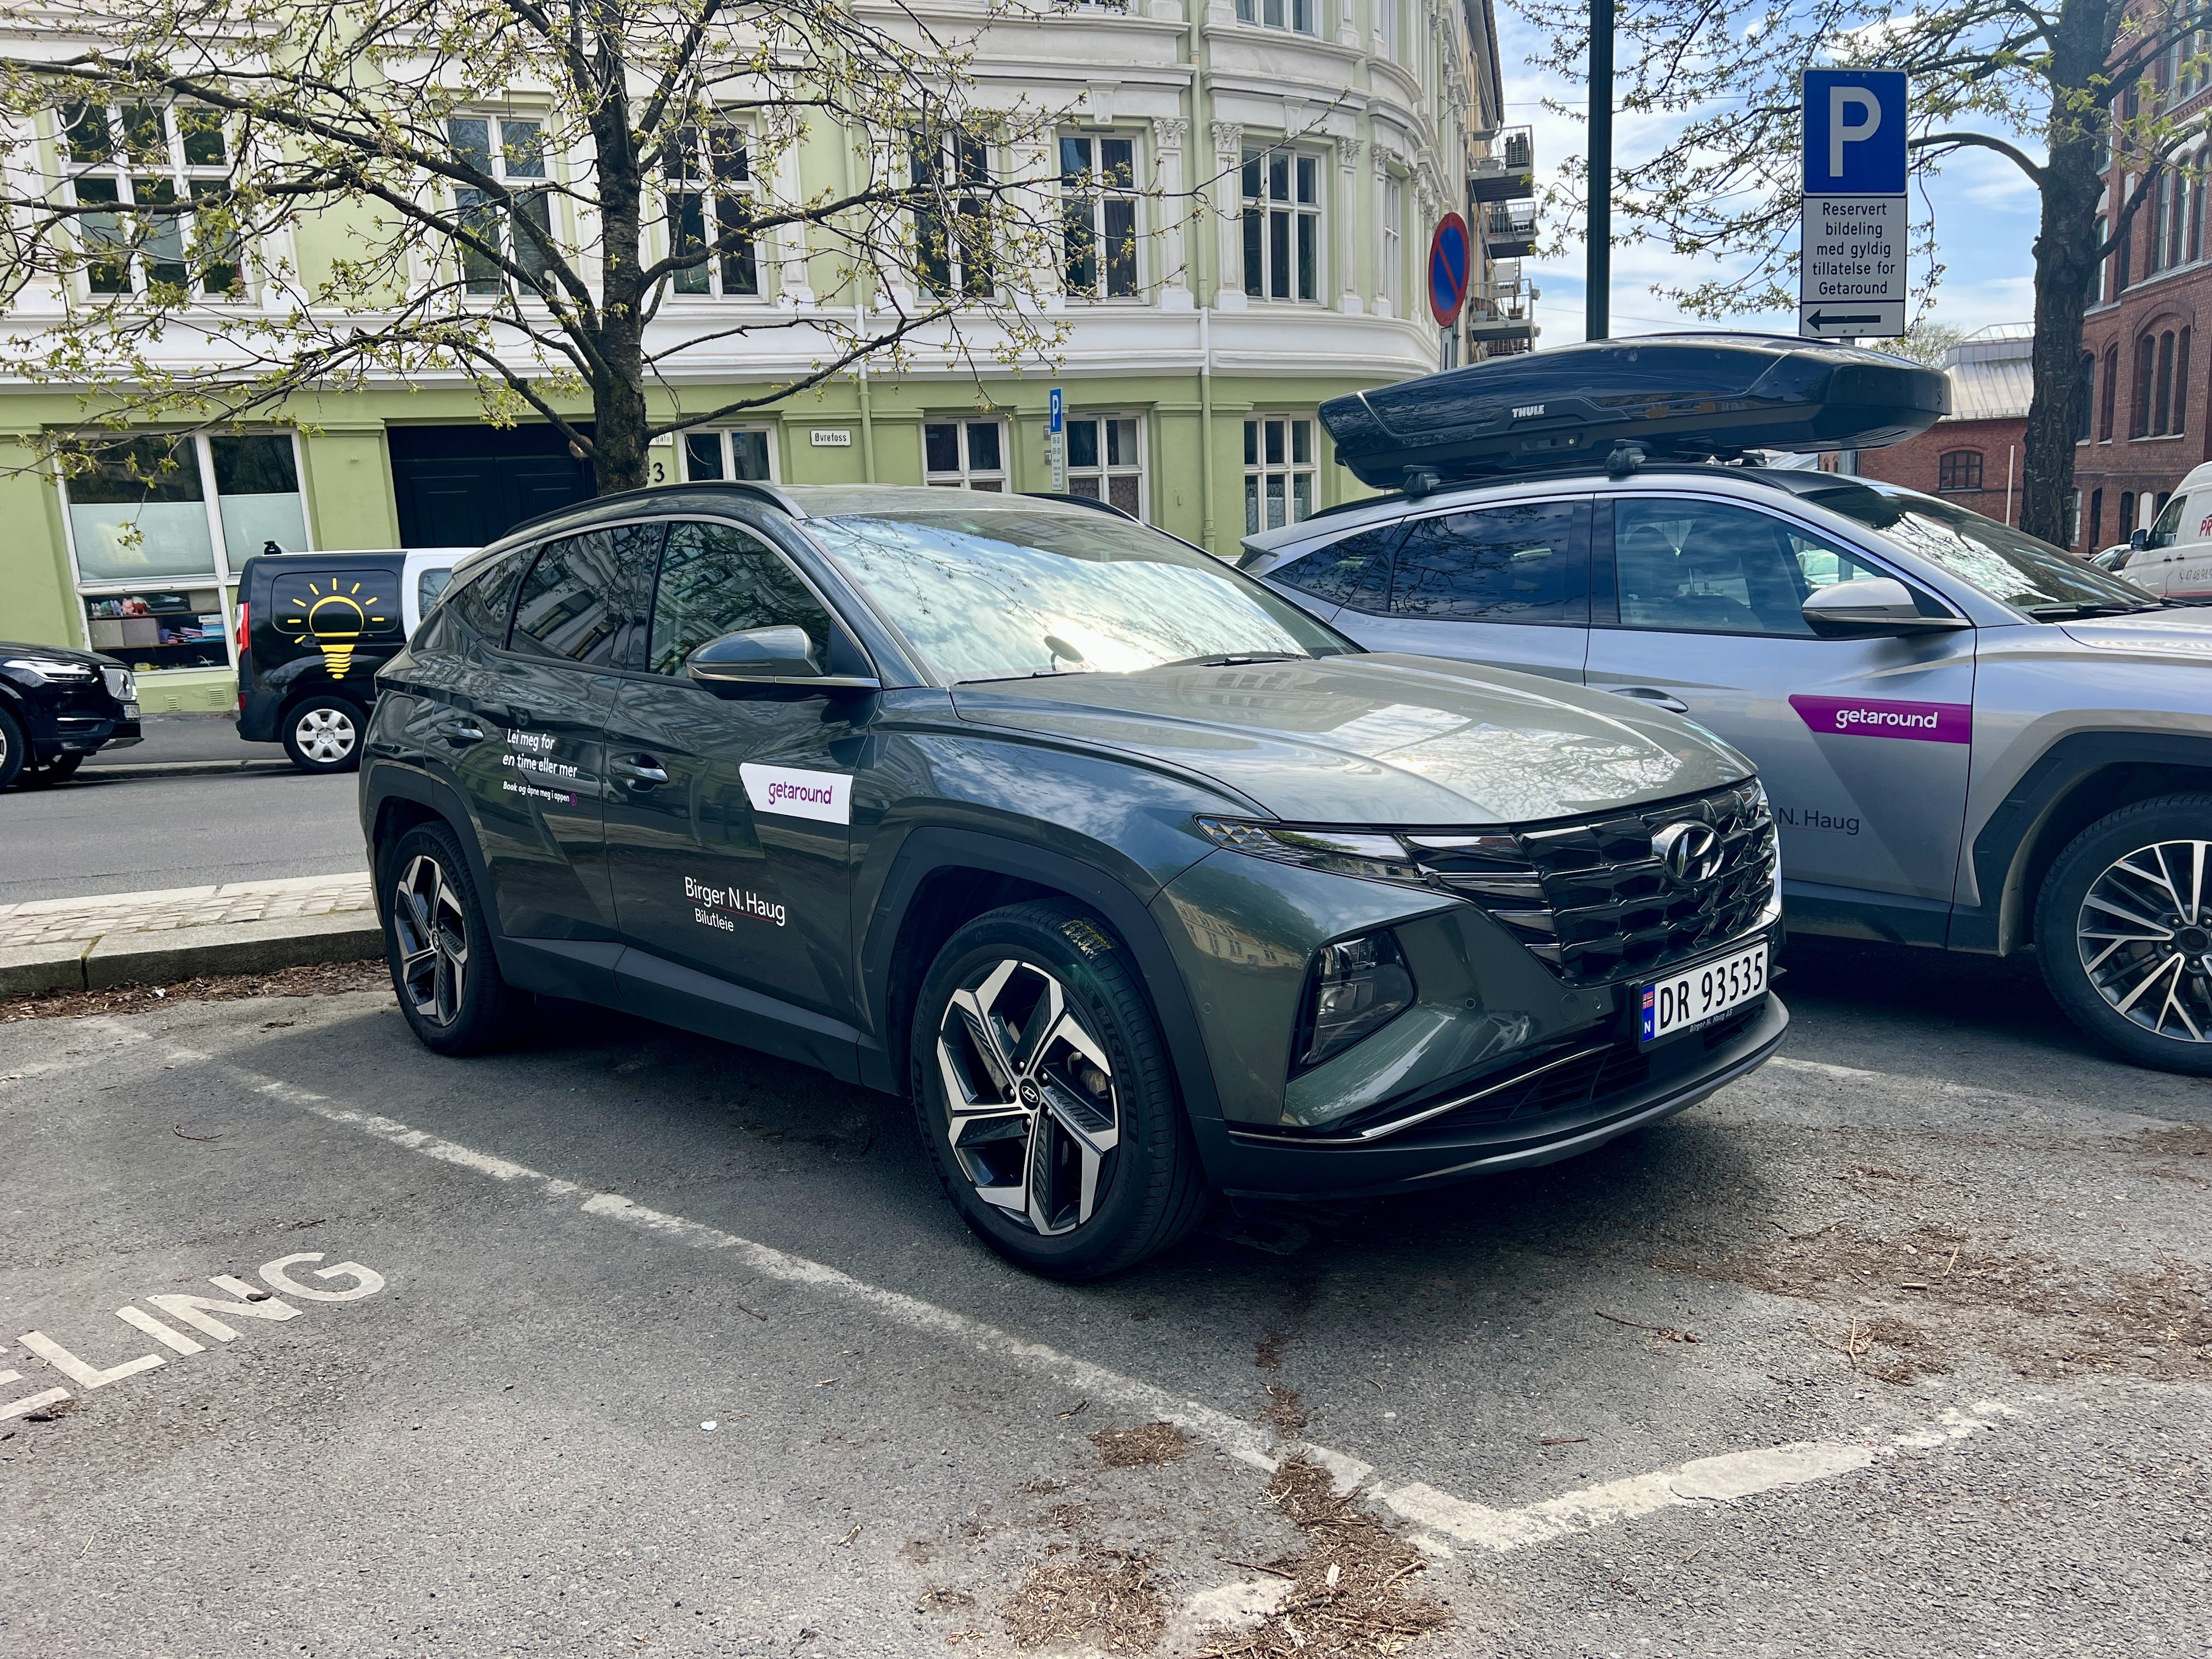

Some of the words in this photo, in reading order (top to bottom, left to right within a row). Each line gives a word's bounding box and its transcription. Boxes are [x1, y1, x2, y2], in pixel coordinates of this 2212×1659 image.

[1830, 86, 1882, 177] P
[1822, 202, 1887, 216] Reservert
[1826, 222, 1883, 238] bildeling
[1817, 241, 1844, 255] med
[1850, 241, 1891, 258] gyldig
[1813, 262, 1871, 275] tillatelse
[1877, 261, 1895, 274] for
[1819, 280, 1887, 295] Getaround
[1052, 394, 1059, 427] P
[1512, 404, 1545, 418] THULE
[815, 432, 847, 442] Øvrefoss
[1835, 708, 1938, 729] getaround
[507, 728, 520, 744] Lei
[520, 734, 539, 752] meg
[541, 733, 555, 749] for
[503, 754, 515, 766] en
[517, 753, 537, 770] time
[538, 757, 557, 774] eller
[559, 764, 578, 777] mer
[503, 781, 517, 792] Book
[518, 786, 526, 795] og
[527, 785, 539, 797] åpne
[540, 789, 551, 800] meg
[551, 790, 554, 799] i
[554, 793, 570, 803] appen
[768, 781, 833, 805] getaround
[1779, 807, 1799, 825] N.
[1804, 809, 1860, 836] Haug
[685, 876, 725, 907] Birger
[728, 887, 744, 911] N.
[746, 890, 785, 927] Haug
[695, 907, 734, 932] Bilutleie
[1660, 980, 1690, 1029] DR
[1701, 951, 1763, 1013] 93535
[1644, 1020, 1651, 1034] N
[1690, 1021, 1706, 1033] Birger
[1712, 1013, 1725, 1023] Haug
[1725, 1008, 1733, 1018] AS
